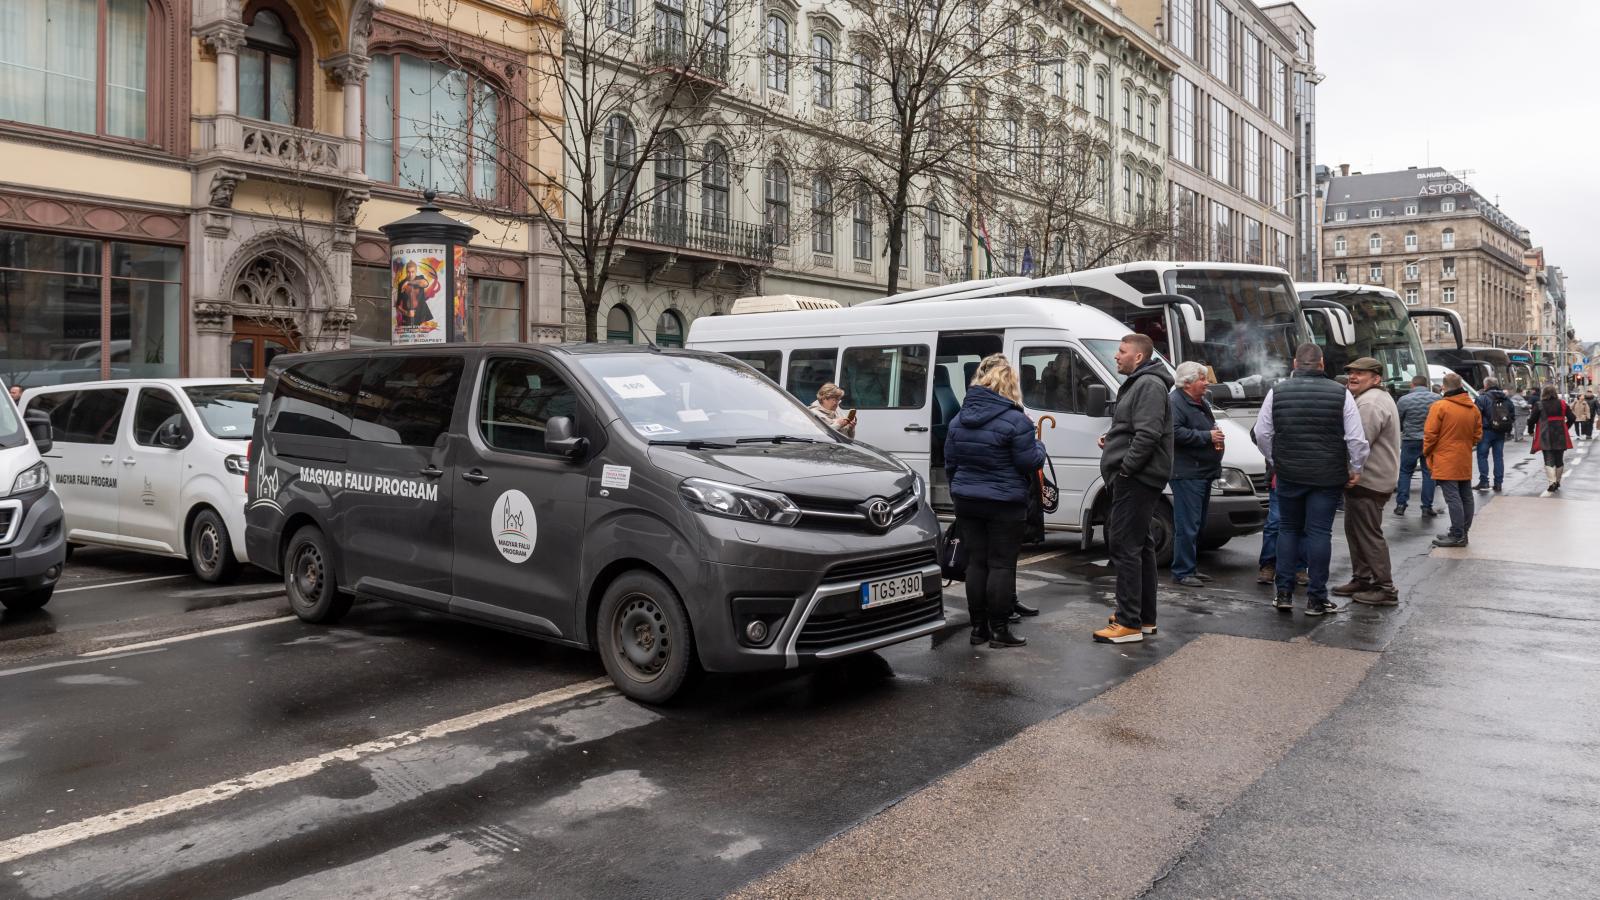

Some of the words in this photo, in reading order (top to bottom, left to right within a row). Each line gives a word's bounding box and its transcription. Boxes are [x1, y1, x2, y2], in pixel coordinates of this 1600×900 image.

[1416, 171, 1450, 179] DANUBIU
[1418, 183, 1471, 195] ASTORIA
[56, 474, 76, 485] MAGYAR
[77, 475, 90, 485] FALU
[91, 476, 117, 488] PROGRAM
[300, 466, 342, 488] MAGYAR
[344, 472, 372, 491] FALU
[374, 476, 438, 501] PROGRAM
[499, 540, 518, 548] MAGYAR
[518, 542, 531, 550] FALU
[502, 547, 527, 557] PROGRAM
[871, 575, 920, 601] TGS-390
